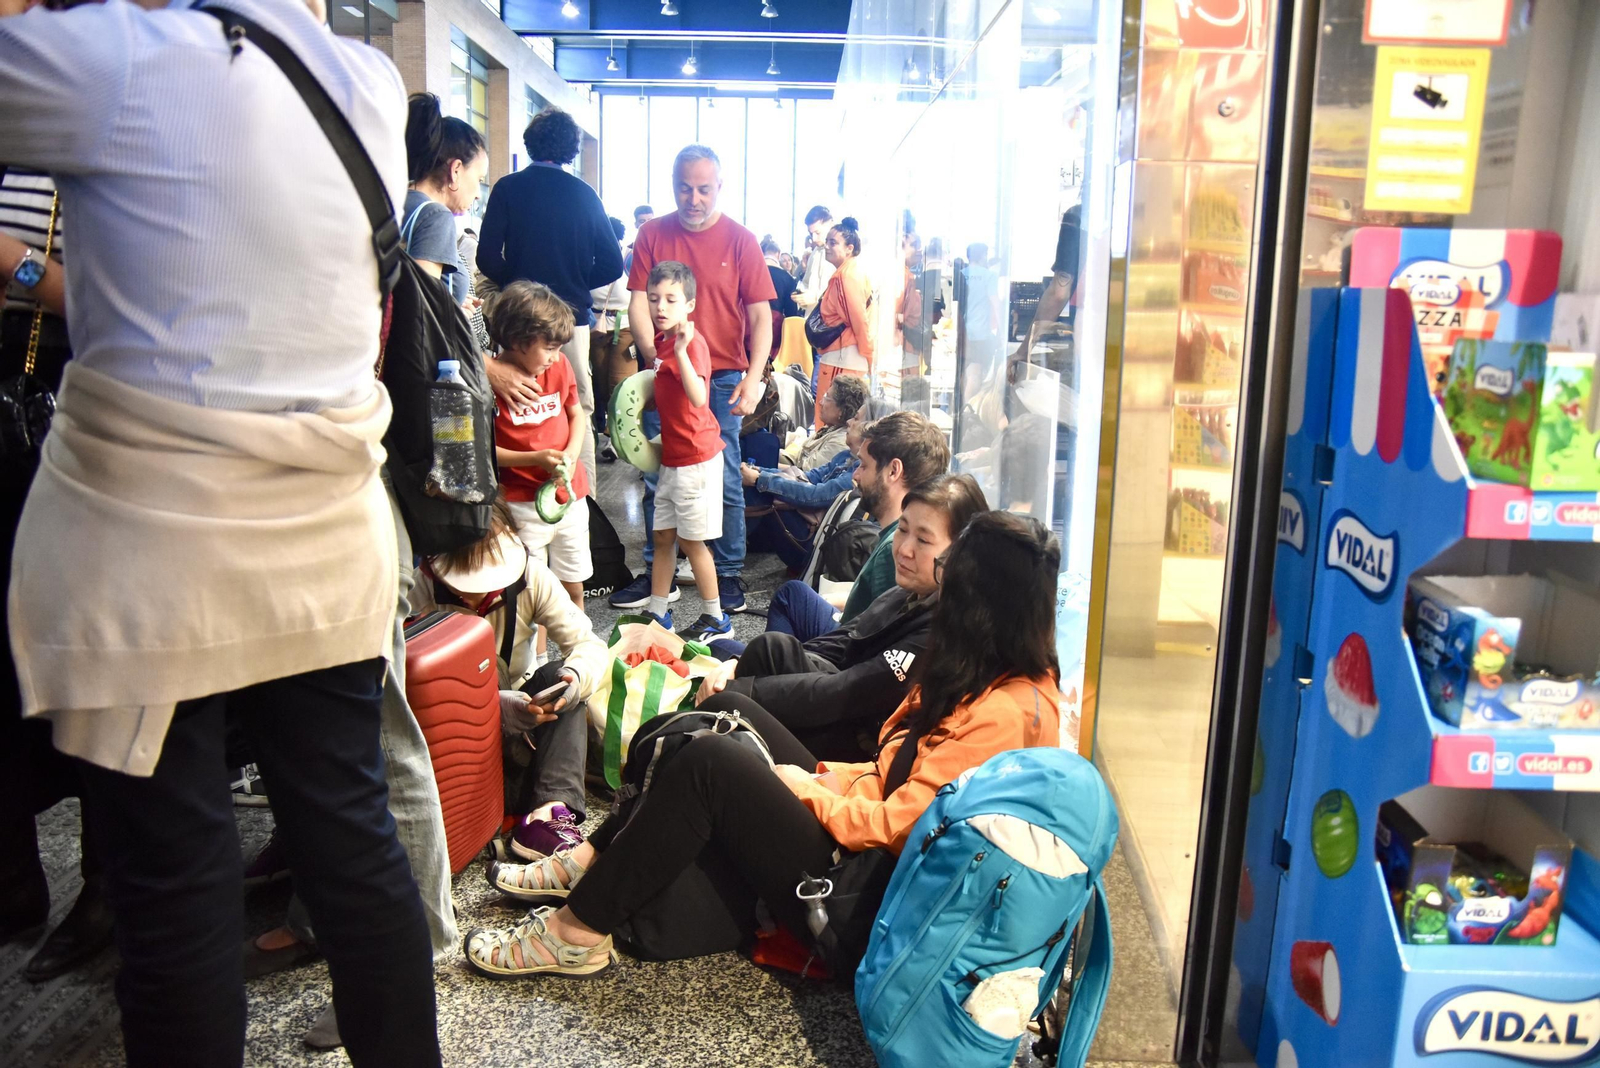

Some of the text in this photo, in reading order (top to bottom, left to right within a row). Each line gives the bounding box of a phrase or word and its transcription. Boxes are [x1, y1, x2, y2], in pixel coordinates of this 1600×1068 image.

[1336, 528, 1387, 582] VIDAL
[883, 649, 907, 682] adidas
[1530, 687, 1571, 697] VIDAL
[1524, 757, 1586, 773] vidal.es
[1464, 908, 1503, 918] VIDAL
[1447, 1009, 1589, 1045] VIDAL
